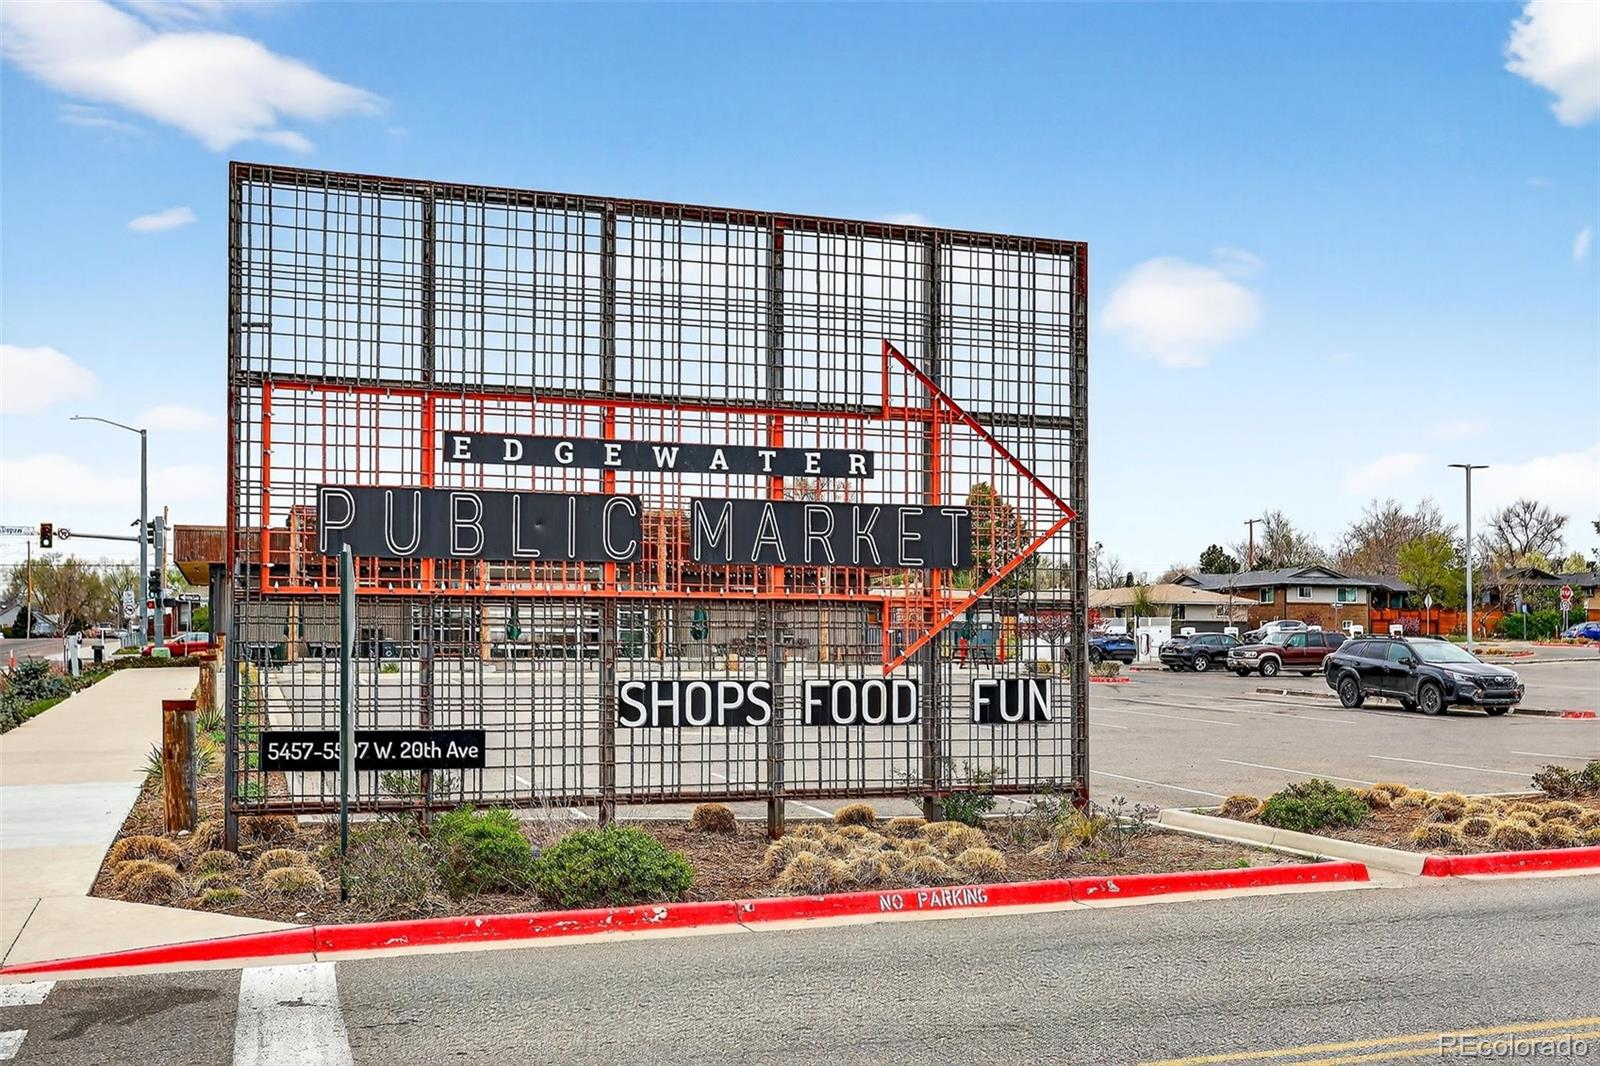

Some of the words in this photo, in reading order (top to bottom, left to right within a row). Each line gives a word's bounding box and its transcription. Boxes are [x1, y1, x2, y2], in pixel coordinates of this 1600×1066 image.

[452, 437, 868, 475] EDGEWATER
[320, 487, 637, 560] PUBLIC
[693, 500, 969, 567] MARKET
[620, 681, 772, 726] SHOPS
[804, 679, 917, 725] FOOD
[973, 678, 1053, 722] FUN
[373, 742, 396, 760] W.
[400, 741, 442, 759] 20th
[446, 741, 479, 759] Ave
[880, 894, 904, 911] NO
[917, 888, 988, 908] PARKING
